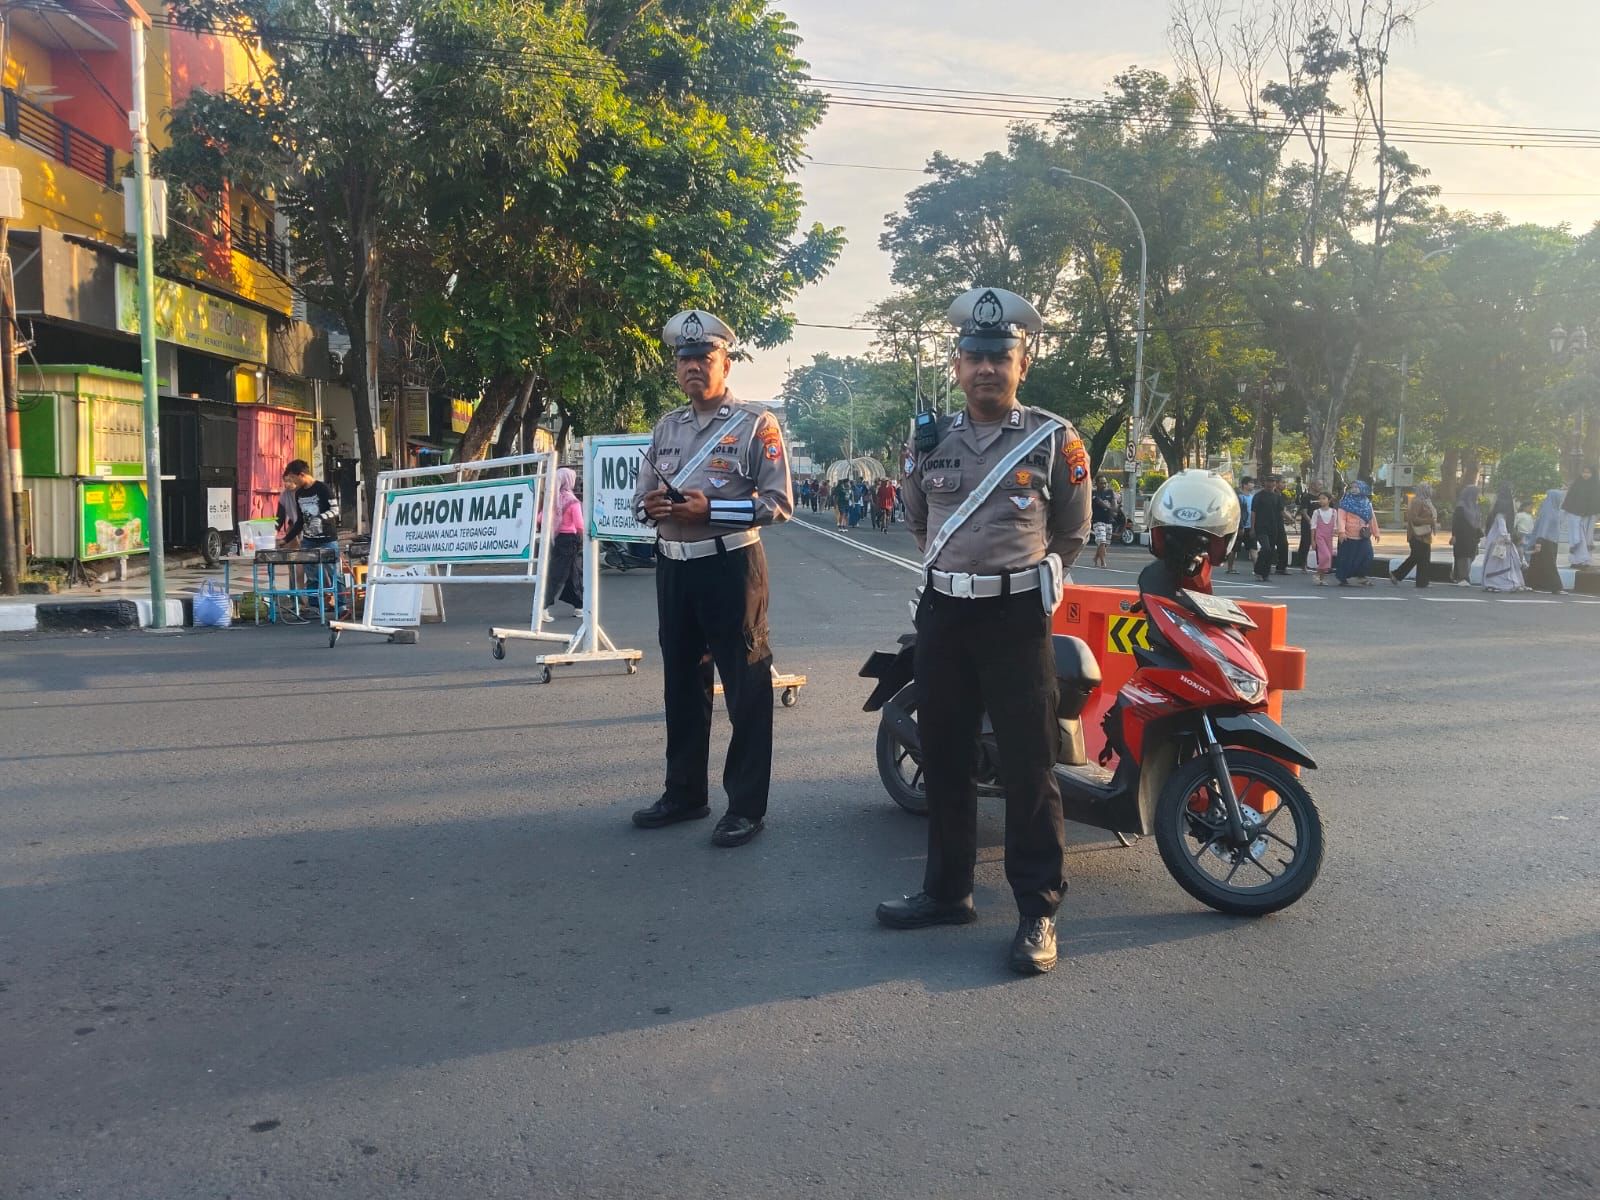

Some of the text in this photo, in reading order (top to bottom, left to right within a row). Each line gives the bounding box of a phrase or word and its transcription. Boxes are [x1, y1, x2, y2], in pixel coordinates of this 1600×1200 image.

[601, 456, 640, 490] MOH
[395, 492, 523, 526] MOHON MAAF
[599, 514, 610, 528] ADA
[405, 526, 497, 541] PERJALANAN ANDA TERGANGGU
[393, 540, 519, 554] ADA KEGIATAN MASJID AGUNG LAMONGAN
[1180, 674, 1211, 697] HONDA
